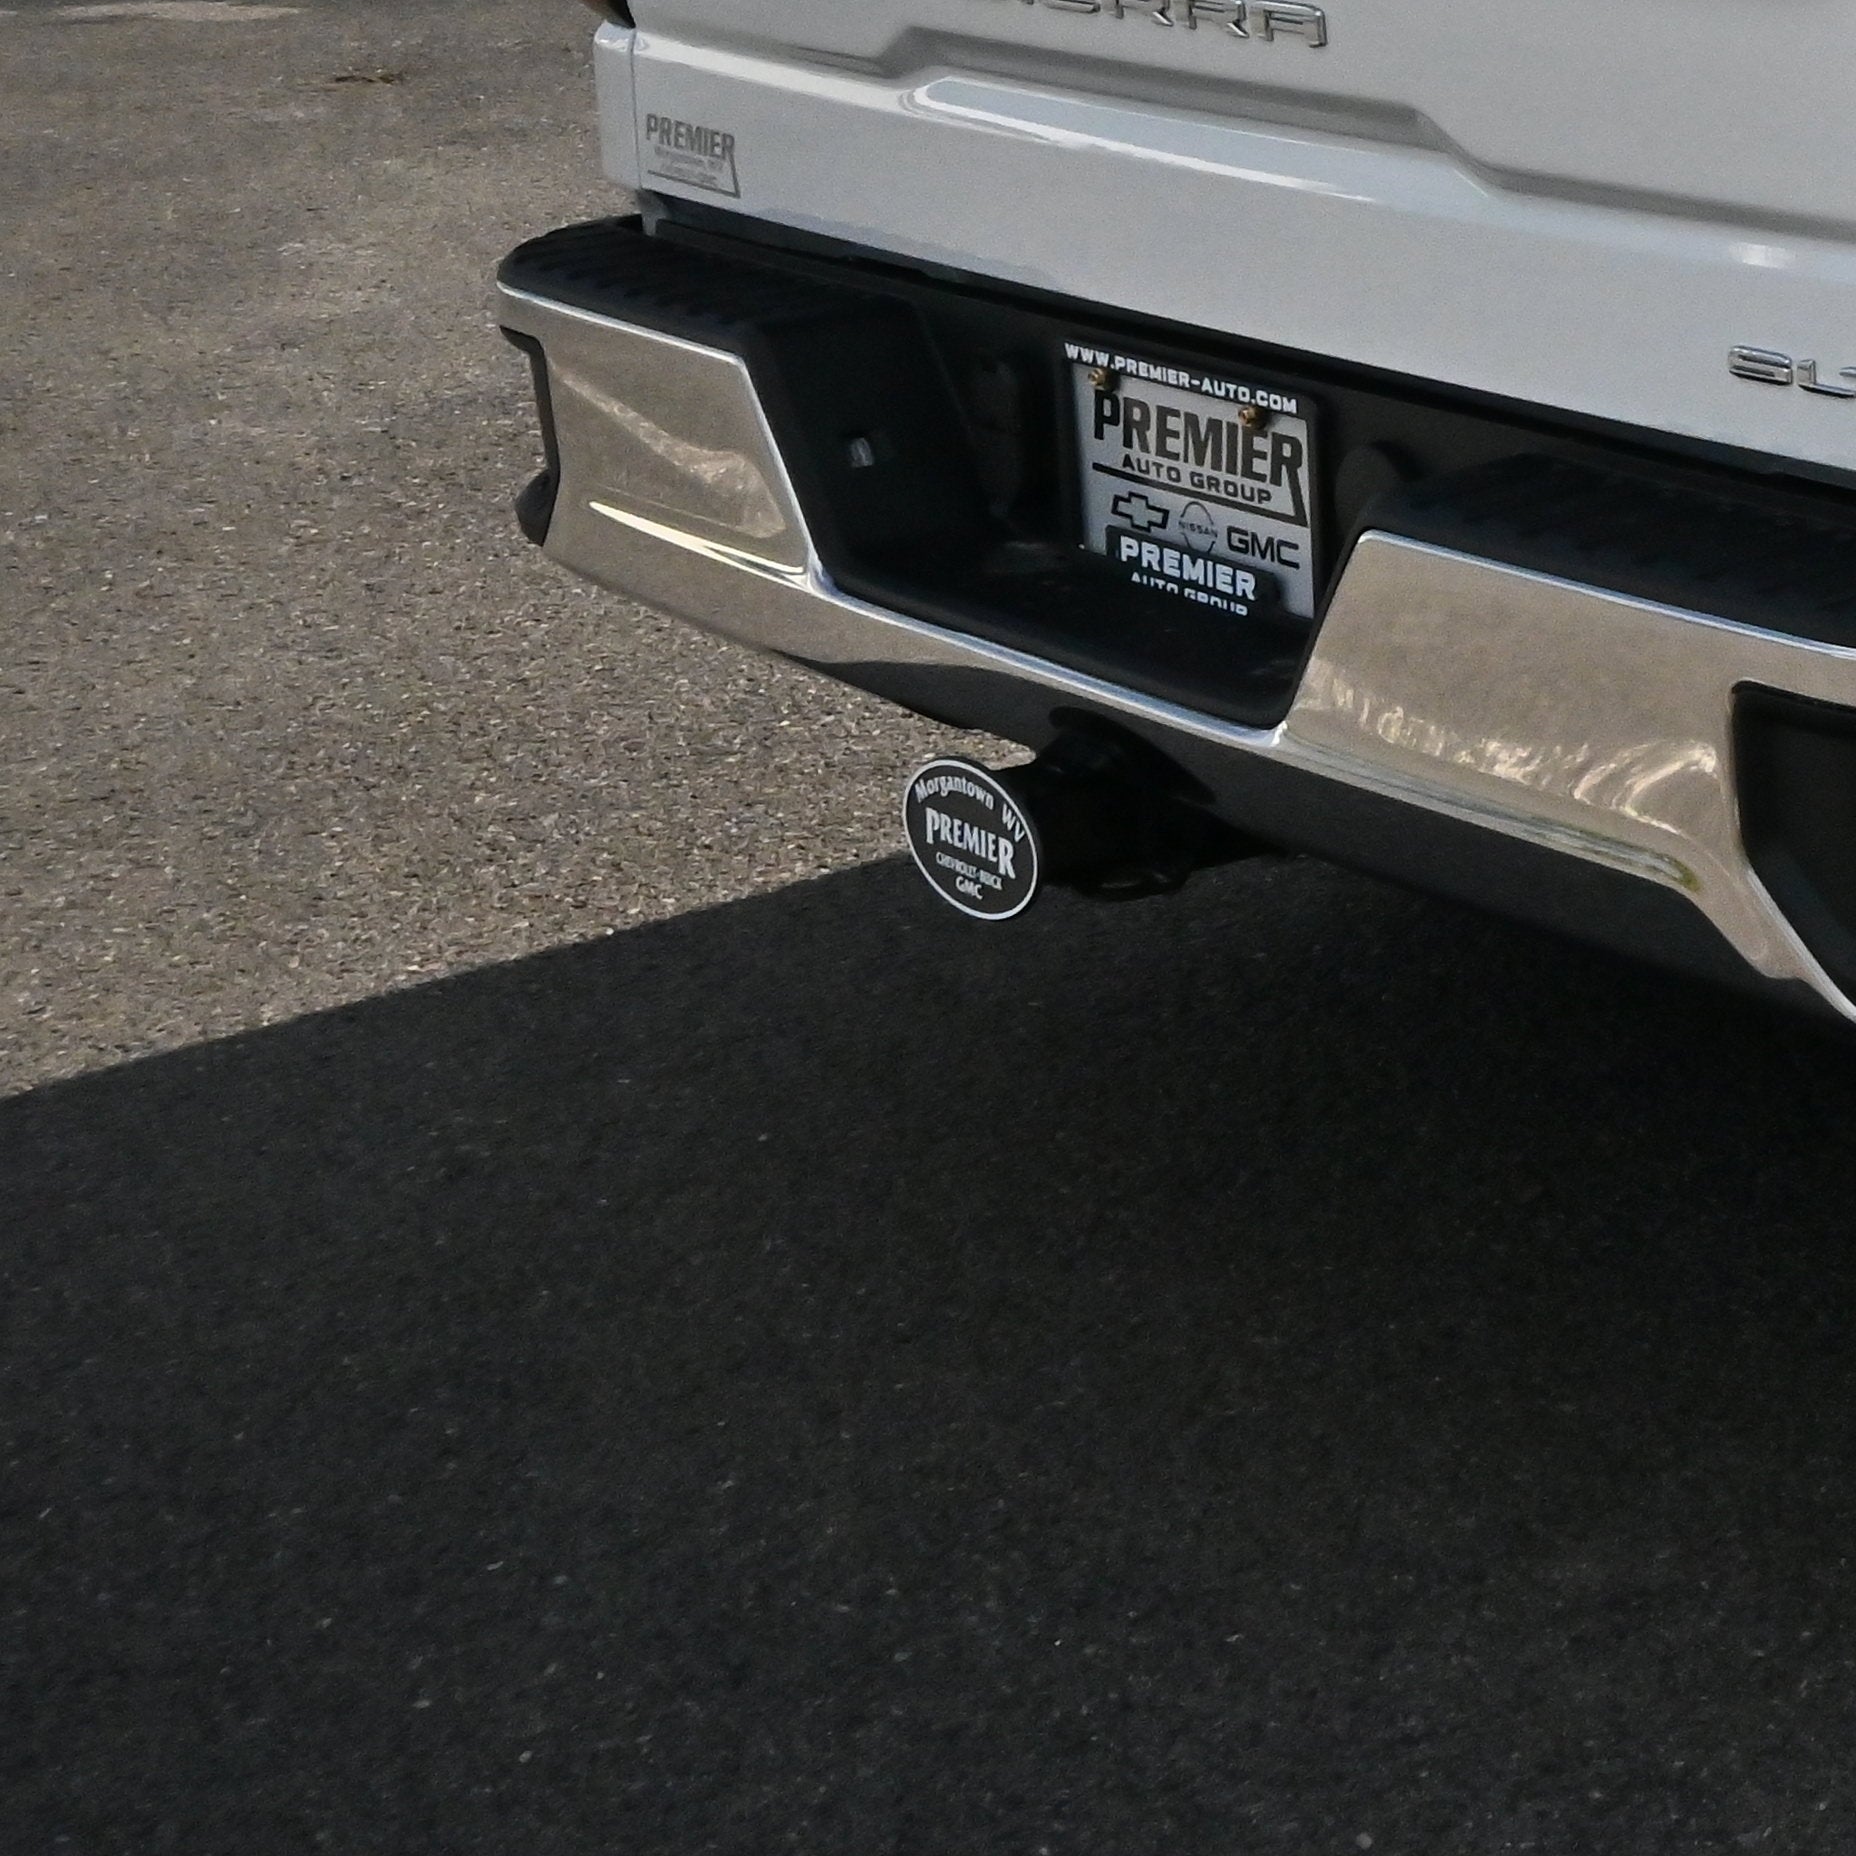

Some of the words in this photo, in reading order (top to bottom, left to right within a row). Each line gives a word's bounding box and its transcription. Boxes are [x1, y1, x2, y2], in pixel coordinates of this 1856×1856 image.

[646, 113, 736, 161] PREMIER
[1064, 343, 1298, 414] WWW.PREMIER-AUTO.COM
[1093, 386, 1306, 494] PREMIER
[1121, 453, 1181, 484] AUTO
[1190, 472, 1272, 505] GROUP
[1119, 536, 1256, 601] PREMIER
[1226, 526, 1300, 570] GMC
[914, 775, 994, 810] Morgantown
[925, 807, 1016, 880] PREMIER
[956, 876, 984, 900] GMC
